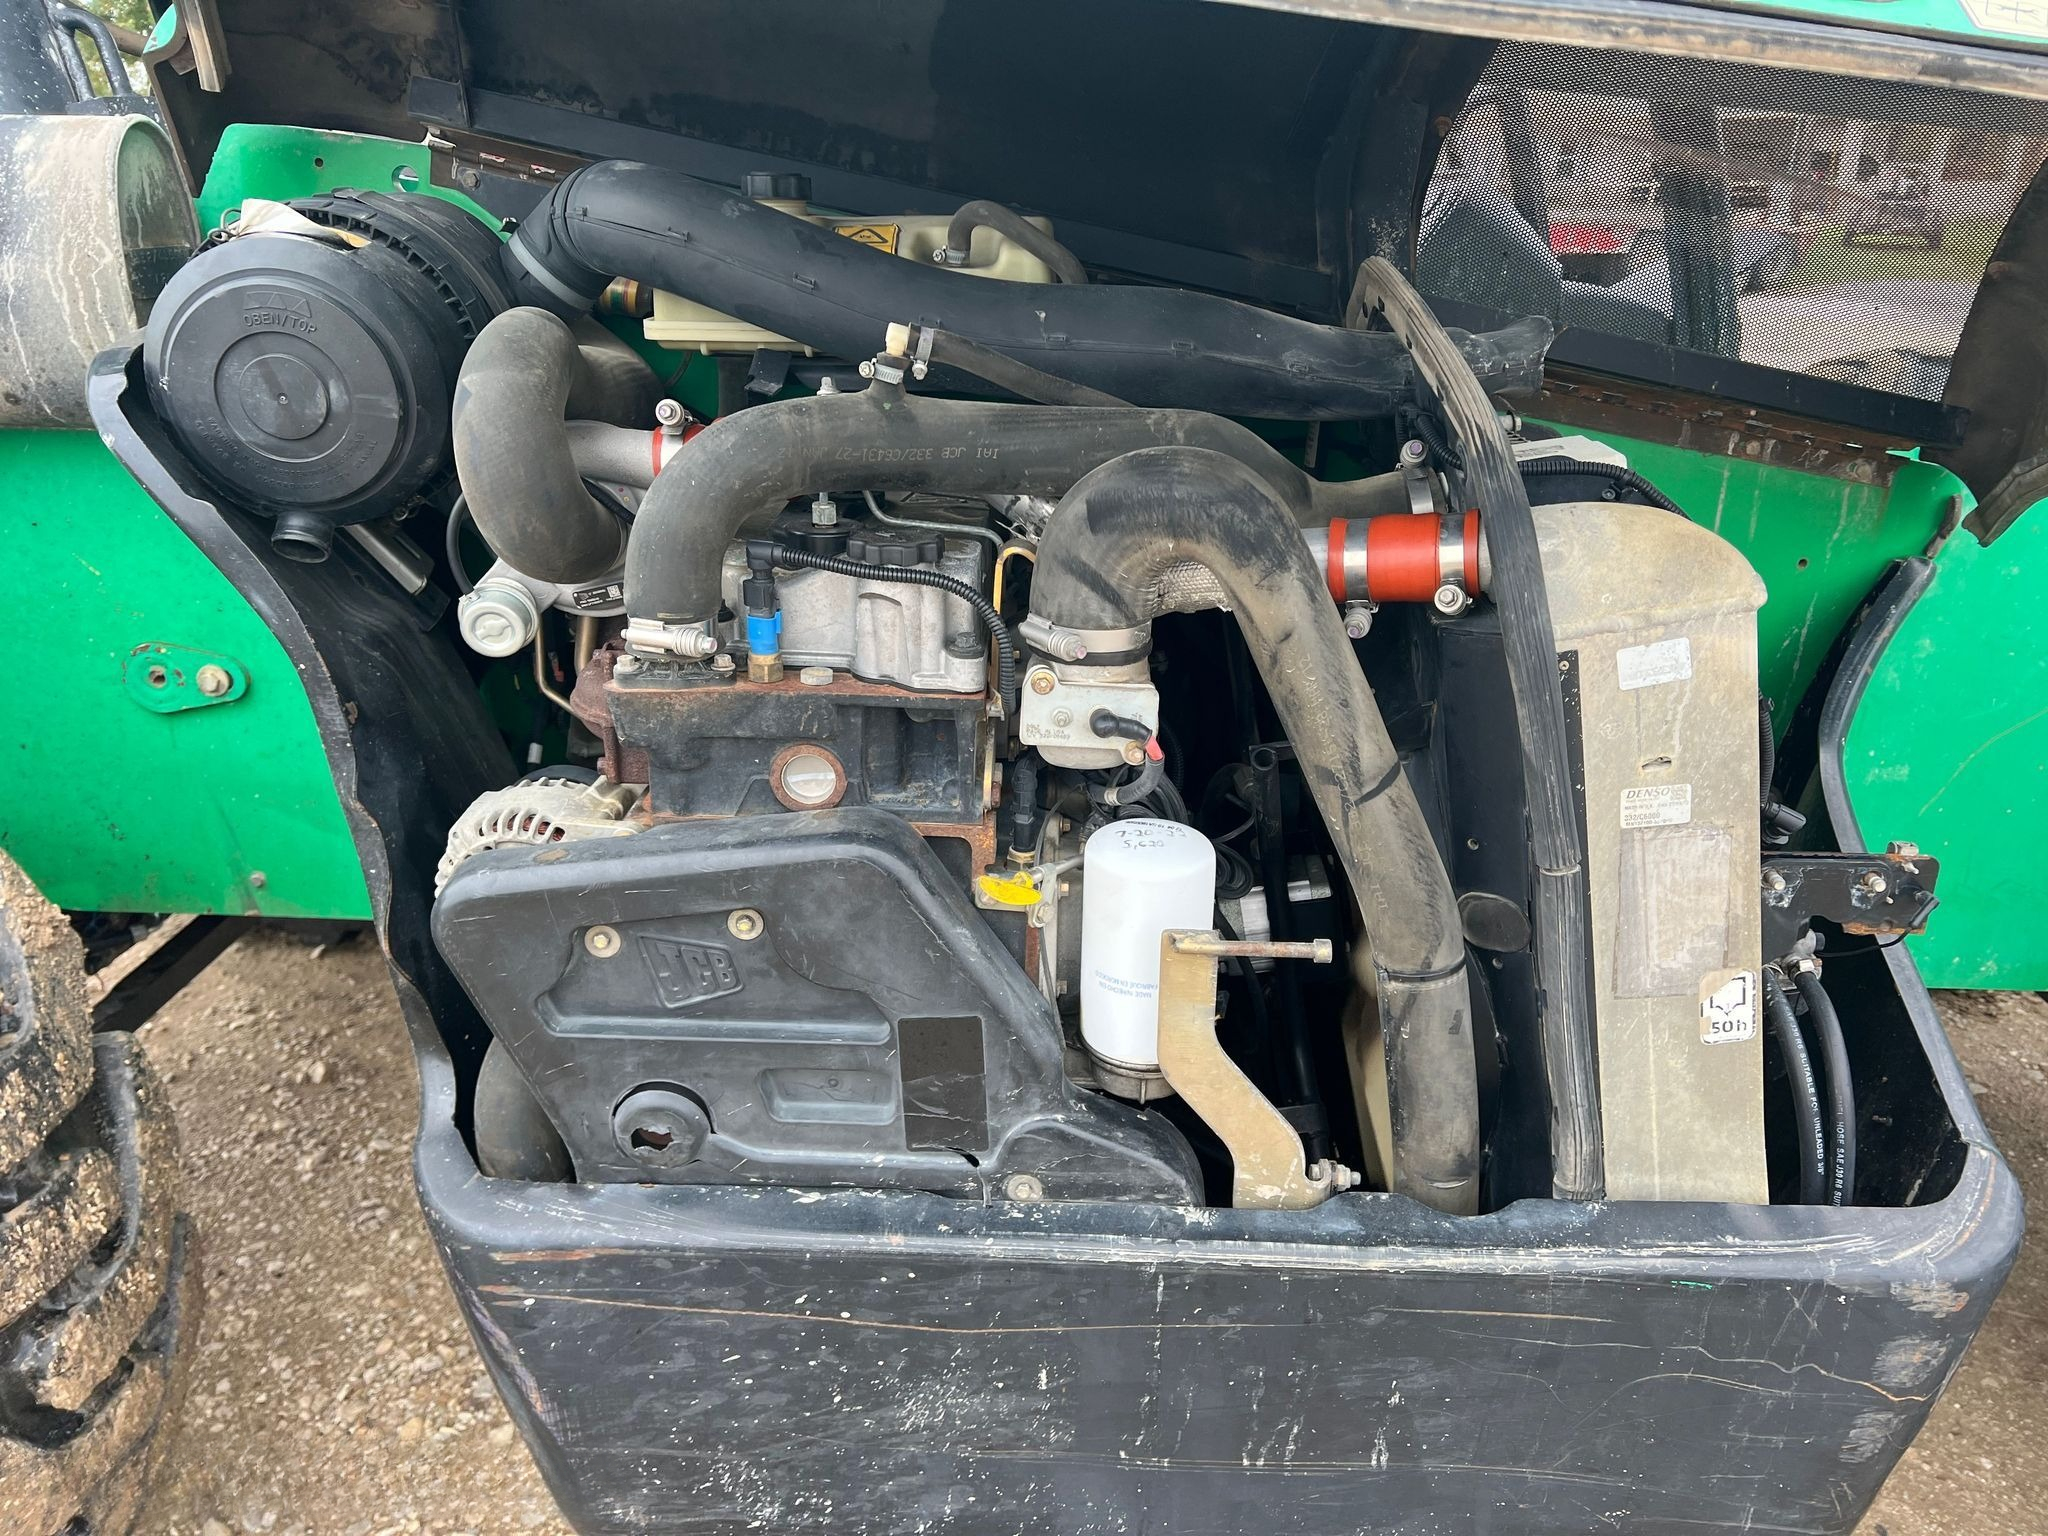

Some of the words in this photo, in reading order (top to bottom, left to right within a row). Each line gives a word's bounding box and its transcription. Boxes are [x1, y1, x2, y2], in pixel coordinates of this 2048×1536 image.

[243, 312, 317, 333] OBEN/TOP
[1626, 786, 1670, 799] DENSO
[1800, 1053, 1815, 1095] SUITABLE
[1814, 1117, 1824, 1160] UNLEADED
[1836, 1147, 1845, 1164] SAE
